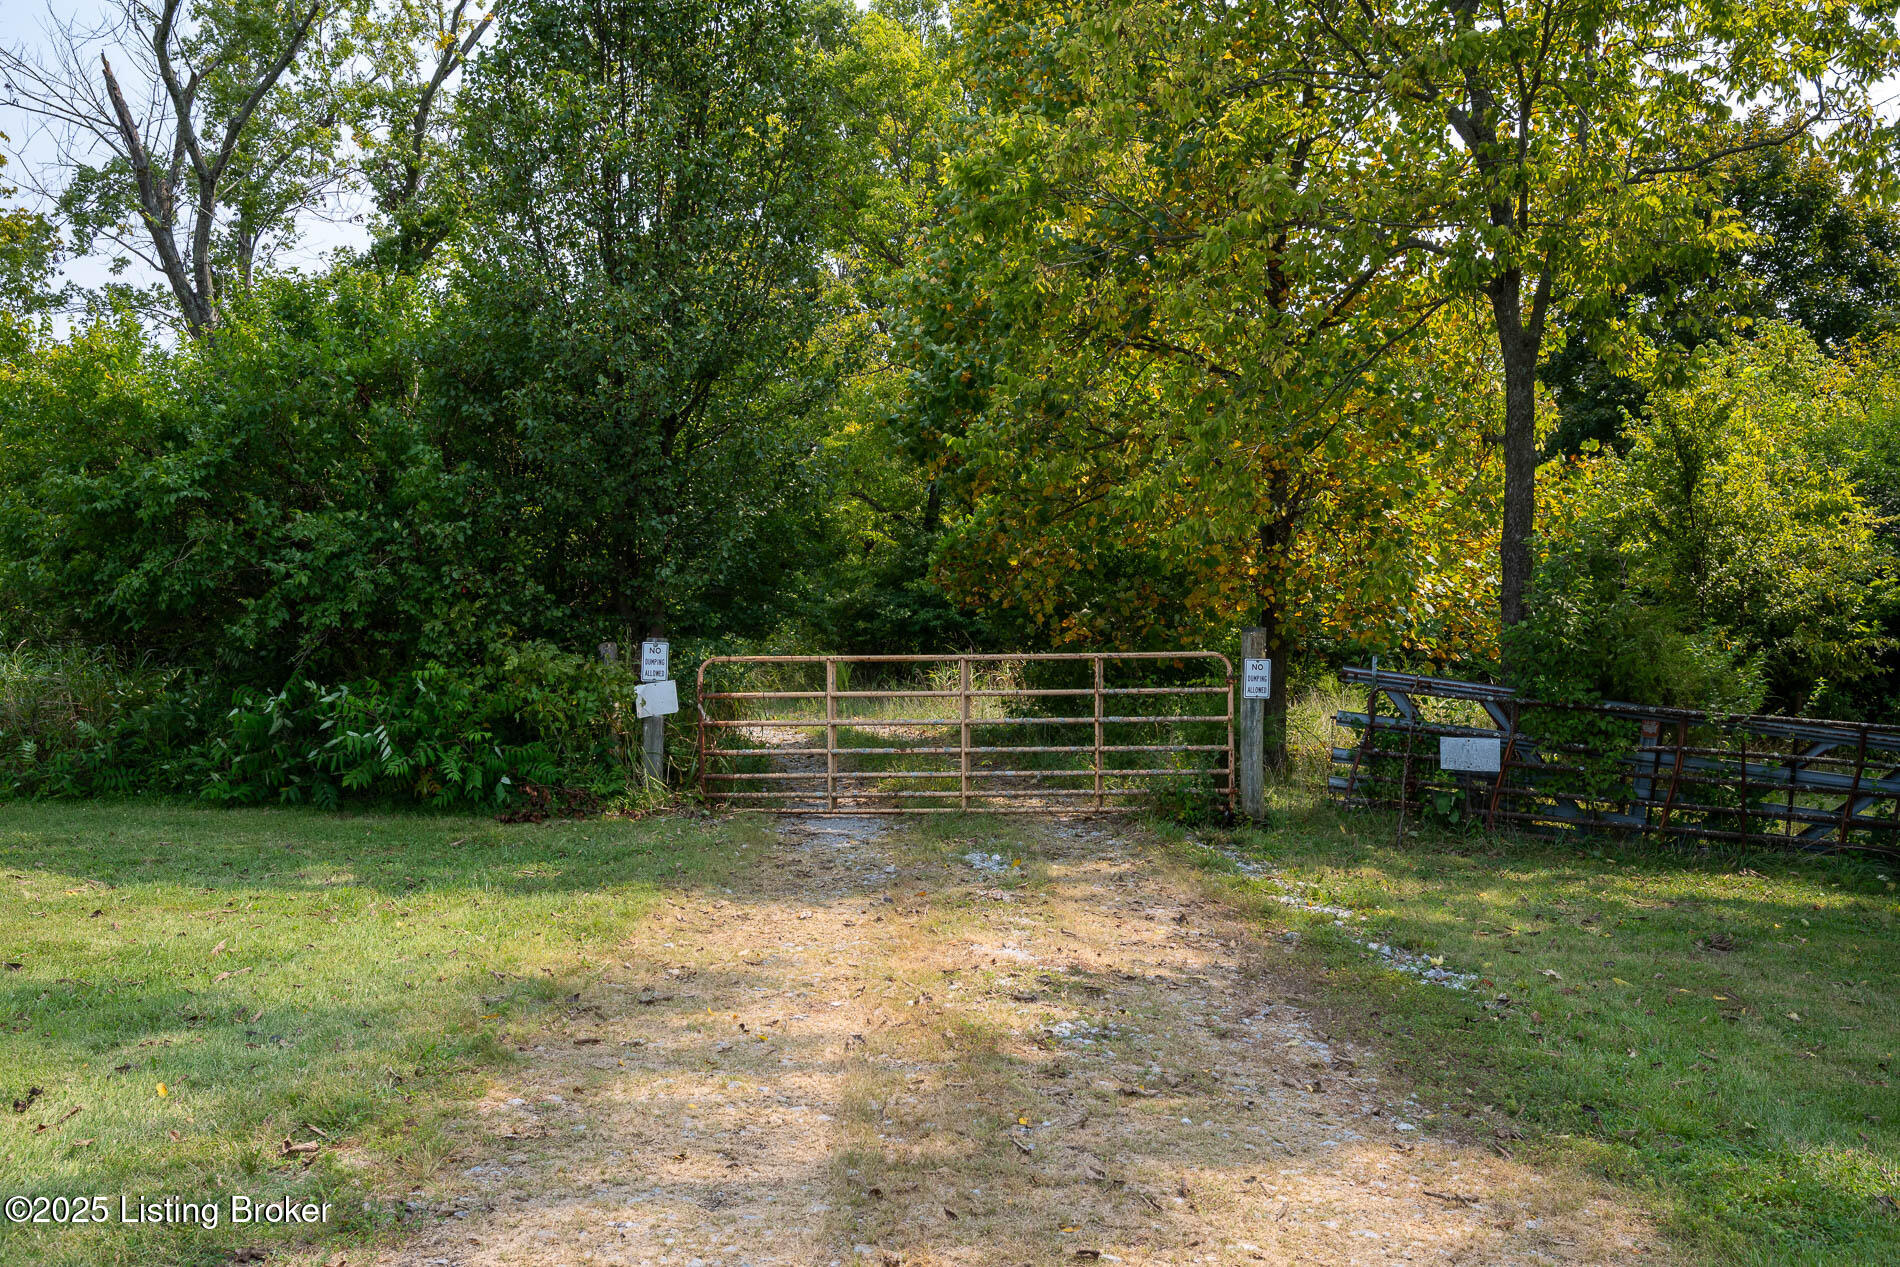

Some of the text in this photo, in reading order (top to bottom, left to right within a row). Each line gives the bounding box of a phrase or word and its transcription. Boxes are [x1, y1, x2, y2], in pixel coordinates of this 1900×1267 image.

[649, 647, 662, 655] NO
[645, 658, 665, 666] DUMPING
[1251, 663, 1264, 671] NO
[1247, 686, 1267, 694] ALLOWED
